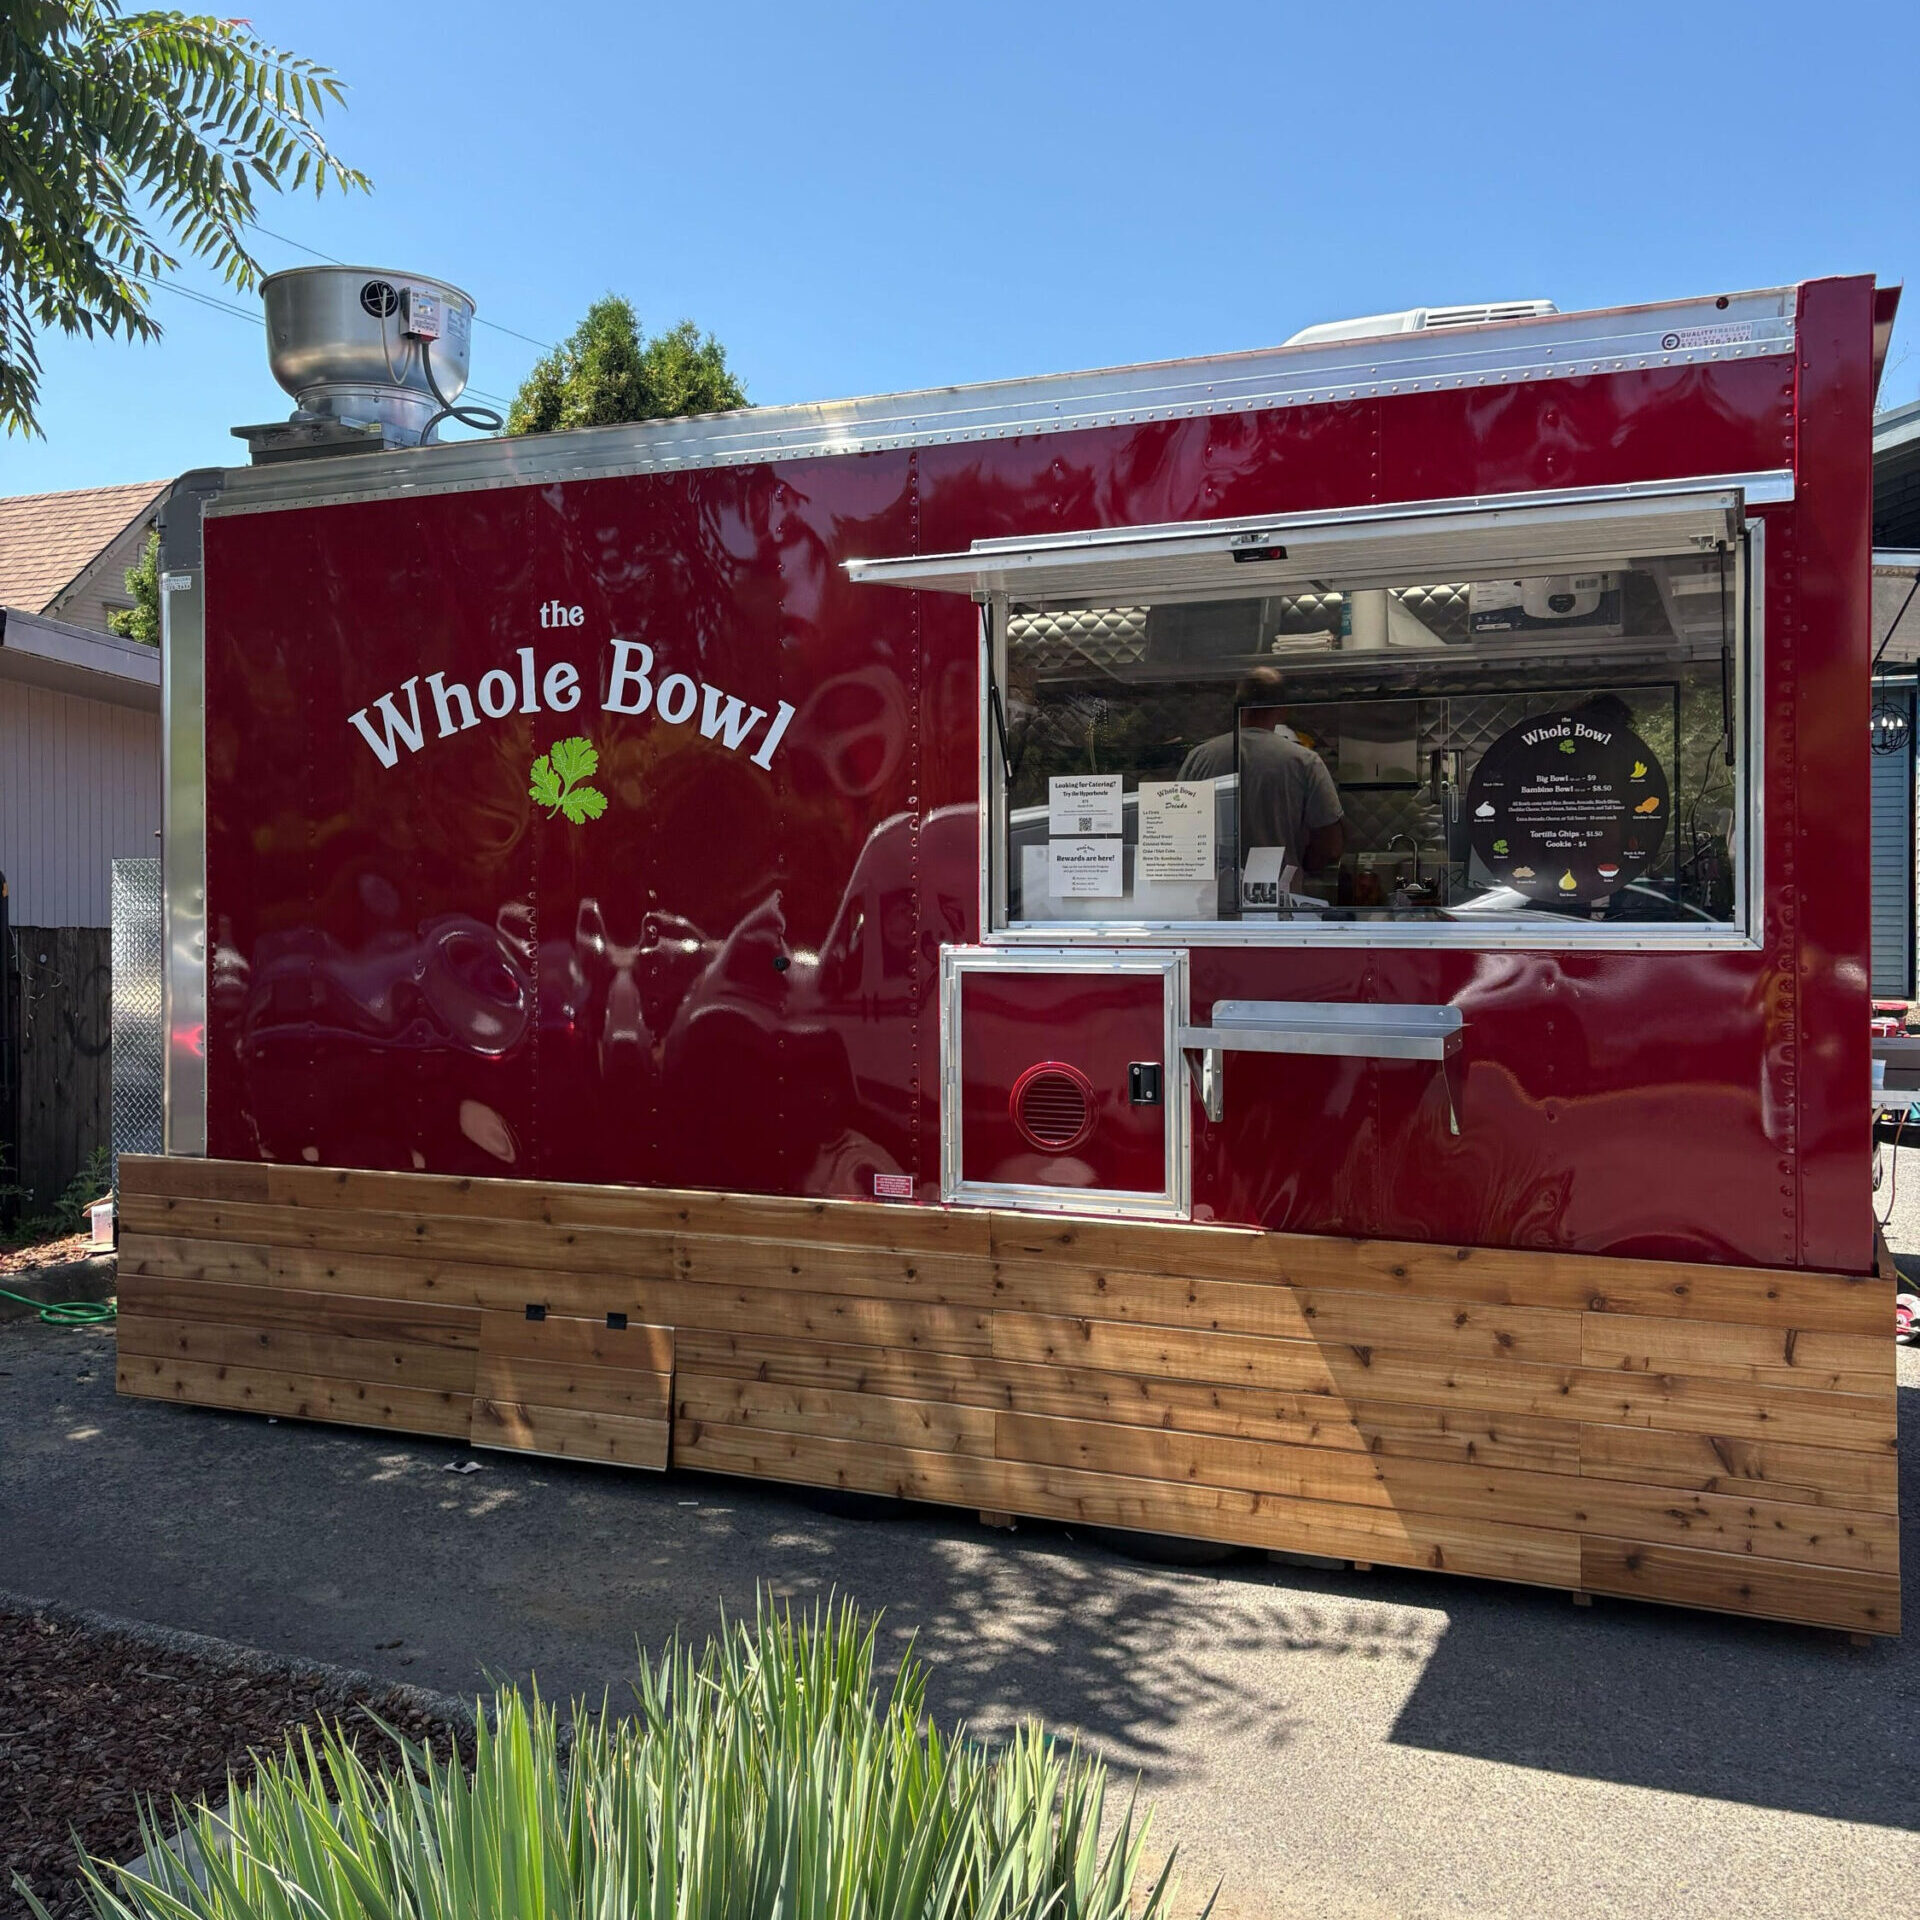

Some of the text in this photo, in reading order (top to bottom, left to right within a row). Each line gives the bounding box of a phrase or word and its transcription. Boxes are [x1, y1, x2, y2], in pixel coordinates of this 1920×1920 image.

[540, 600, 584, 628] the
[348, 639, 796, 771] Whole Bowl
[1521, 723, 1612, 746] Whole Bowl
[1055, 782, 1078, 790] Looking
[1088, 781, 1117, 789] Catering?
[1536, 775, 1549, 784] Big
[1550, 774, 1568, 782] Bowl
[1587, 774, 1597, 782] $9
[1530, 830, 1557, 838] Tortilla
[1559, 830, 1580, 839] Chips
